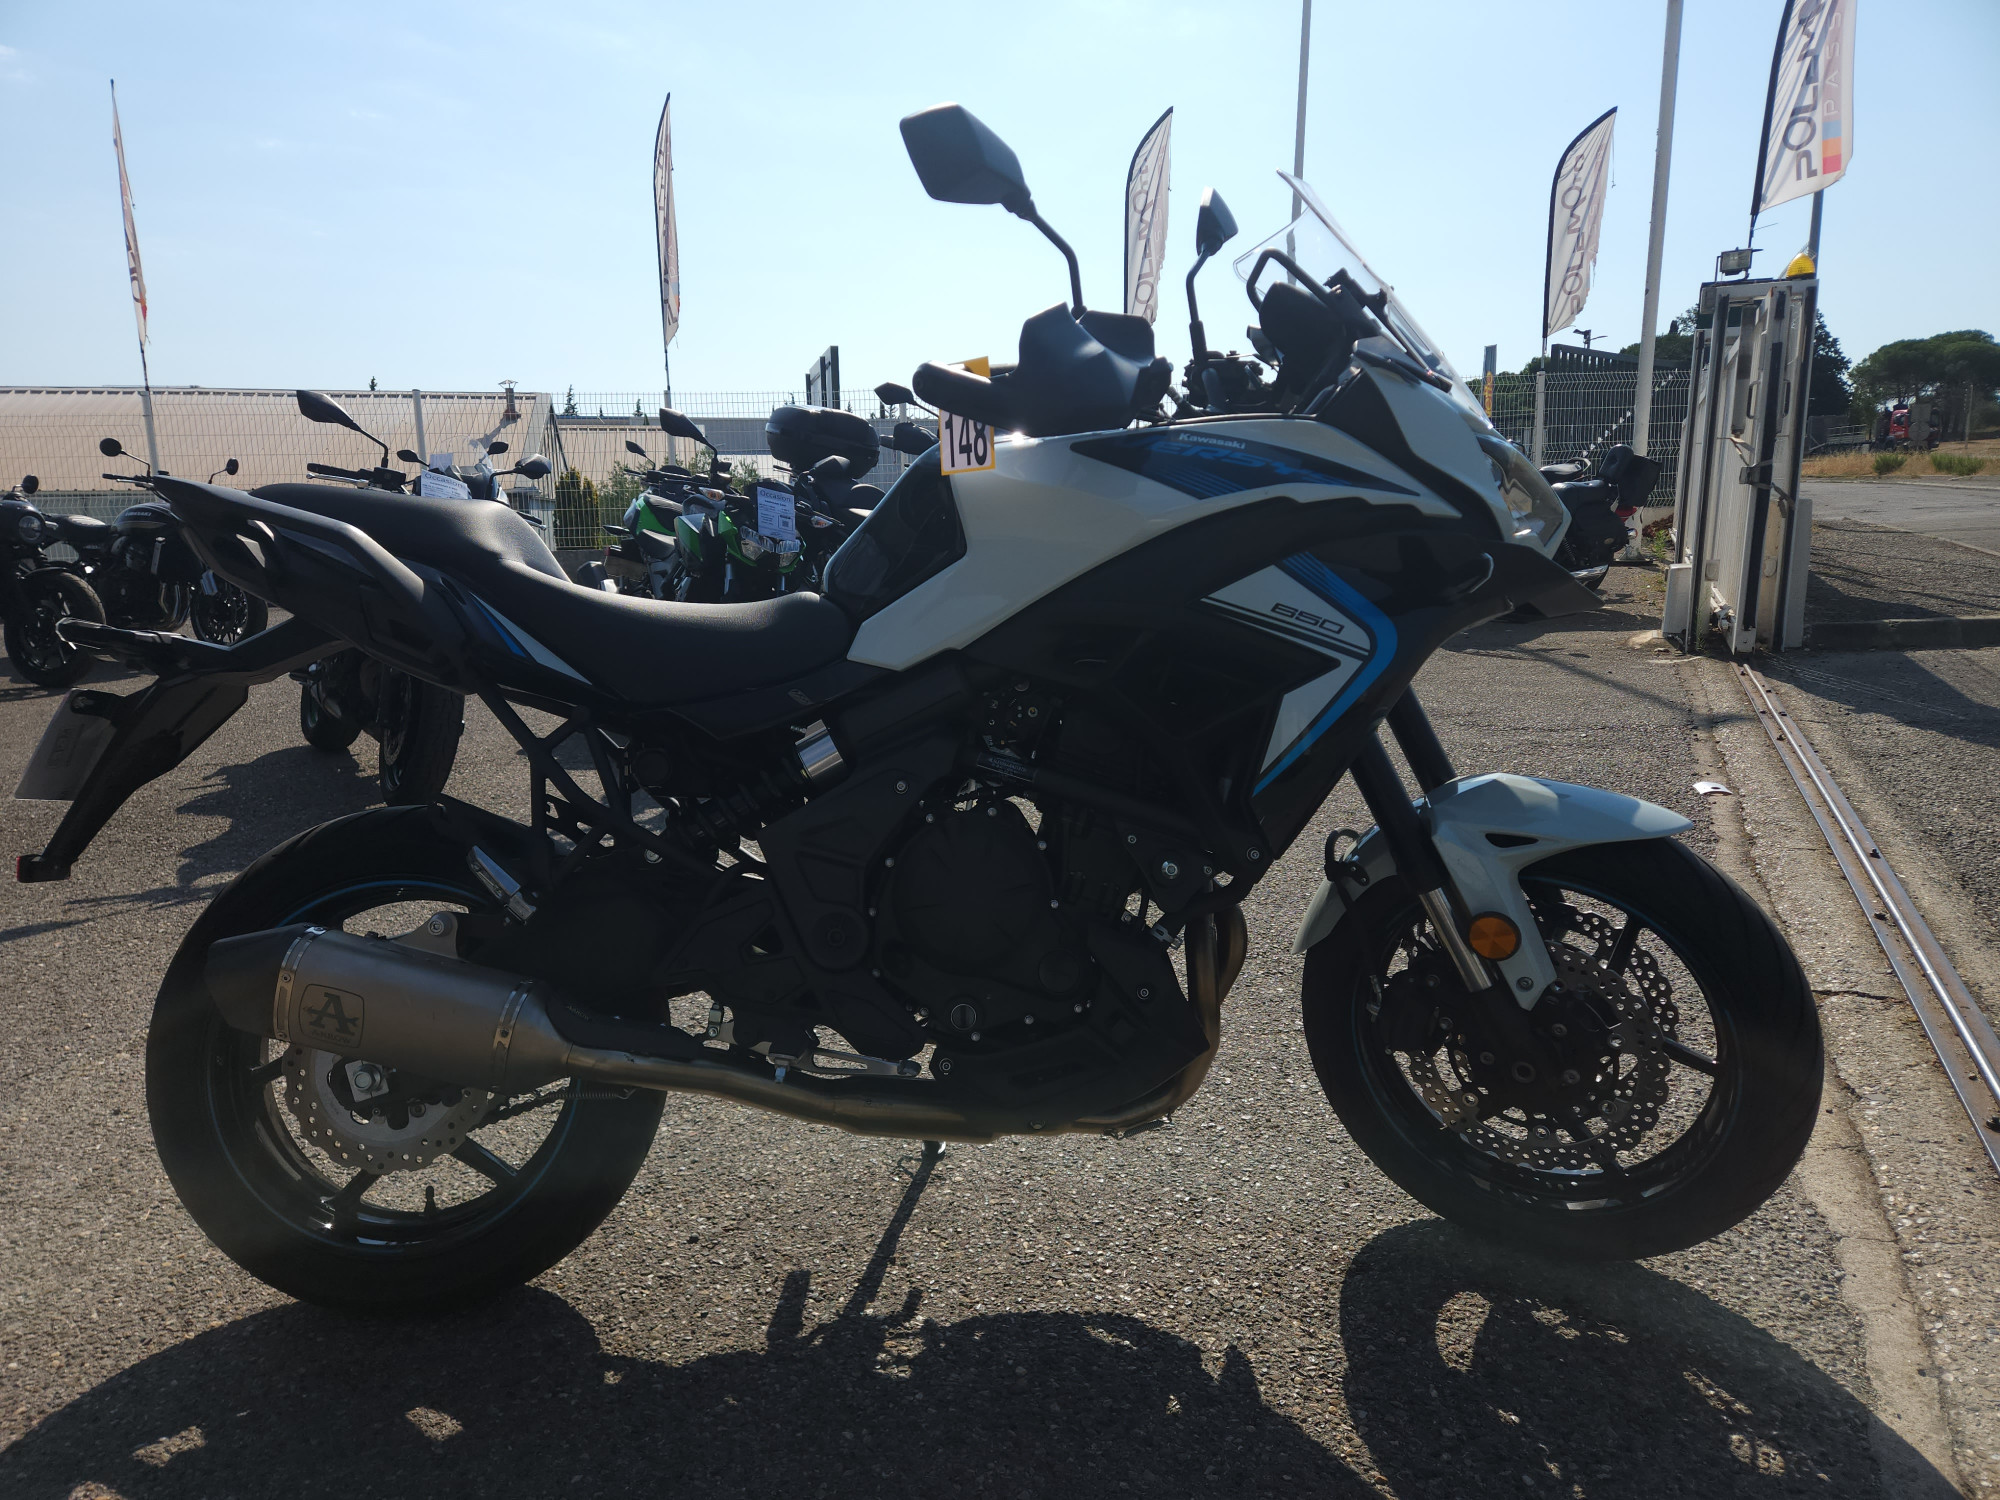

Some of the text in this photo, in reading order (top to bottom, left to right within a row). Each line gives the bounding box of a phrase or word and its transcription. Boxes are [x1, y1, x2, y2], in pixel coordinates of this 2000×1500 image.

[944, 413, 988, 467] 148
[1178, 432, 1246, 450] Kawasaki
[424, 472, 464, 488] Occasion
[760, 489, 791, 502] Occasion
[1270, 602, 1345, 635] 650
